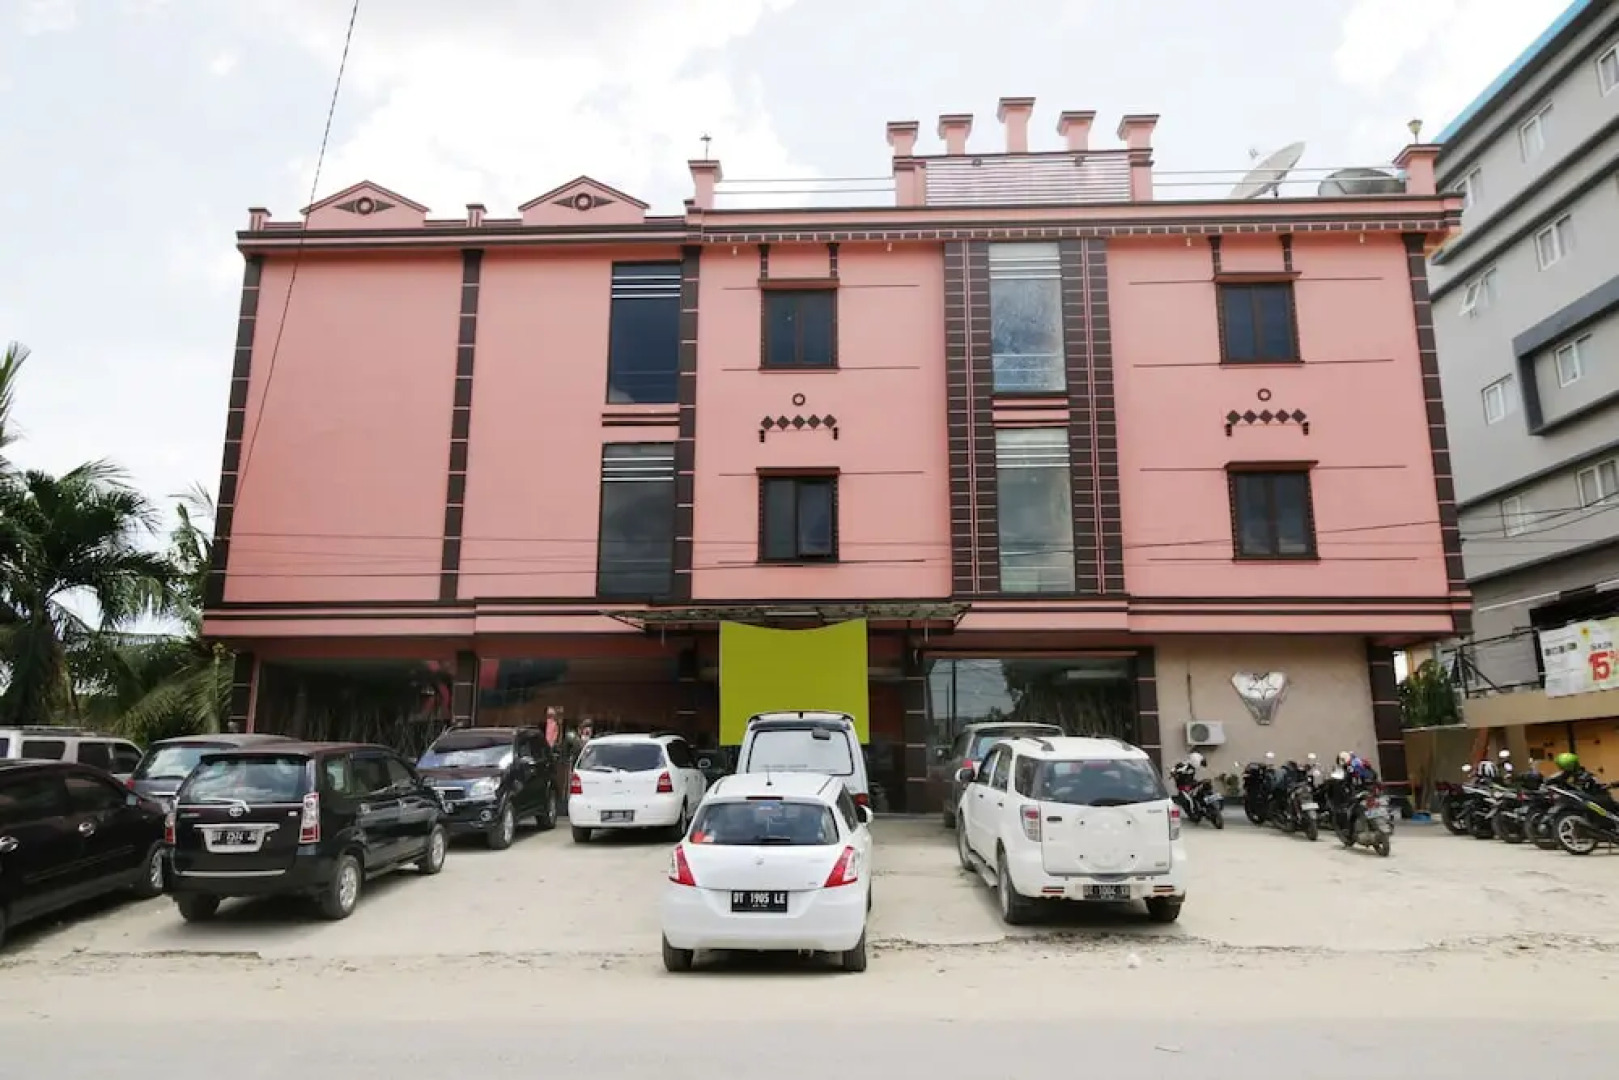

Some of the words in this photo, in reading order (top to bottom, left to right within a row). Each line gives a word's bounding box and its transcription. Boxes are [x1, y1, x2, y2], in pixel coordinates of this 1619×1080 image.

[733, 892, 744, 904] DT
[750, 892, 770, 904] 1905
[773, 892, 786, 904] LE
